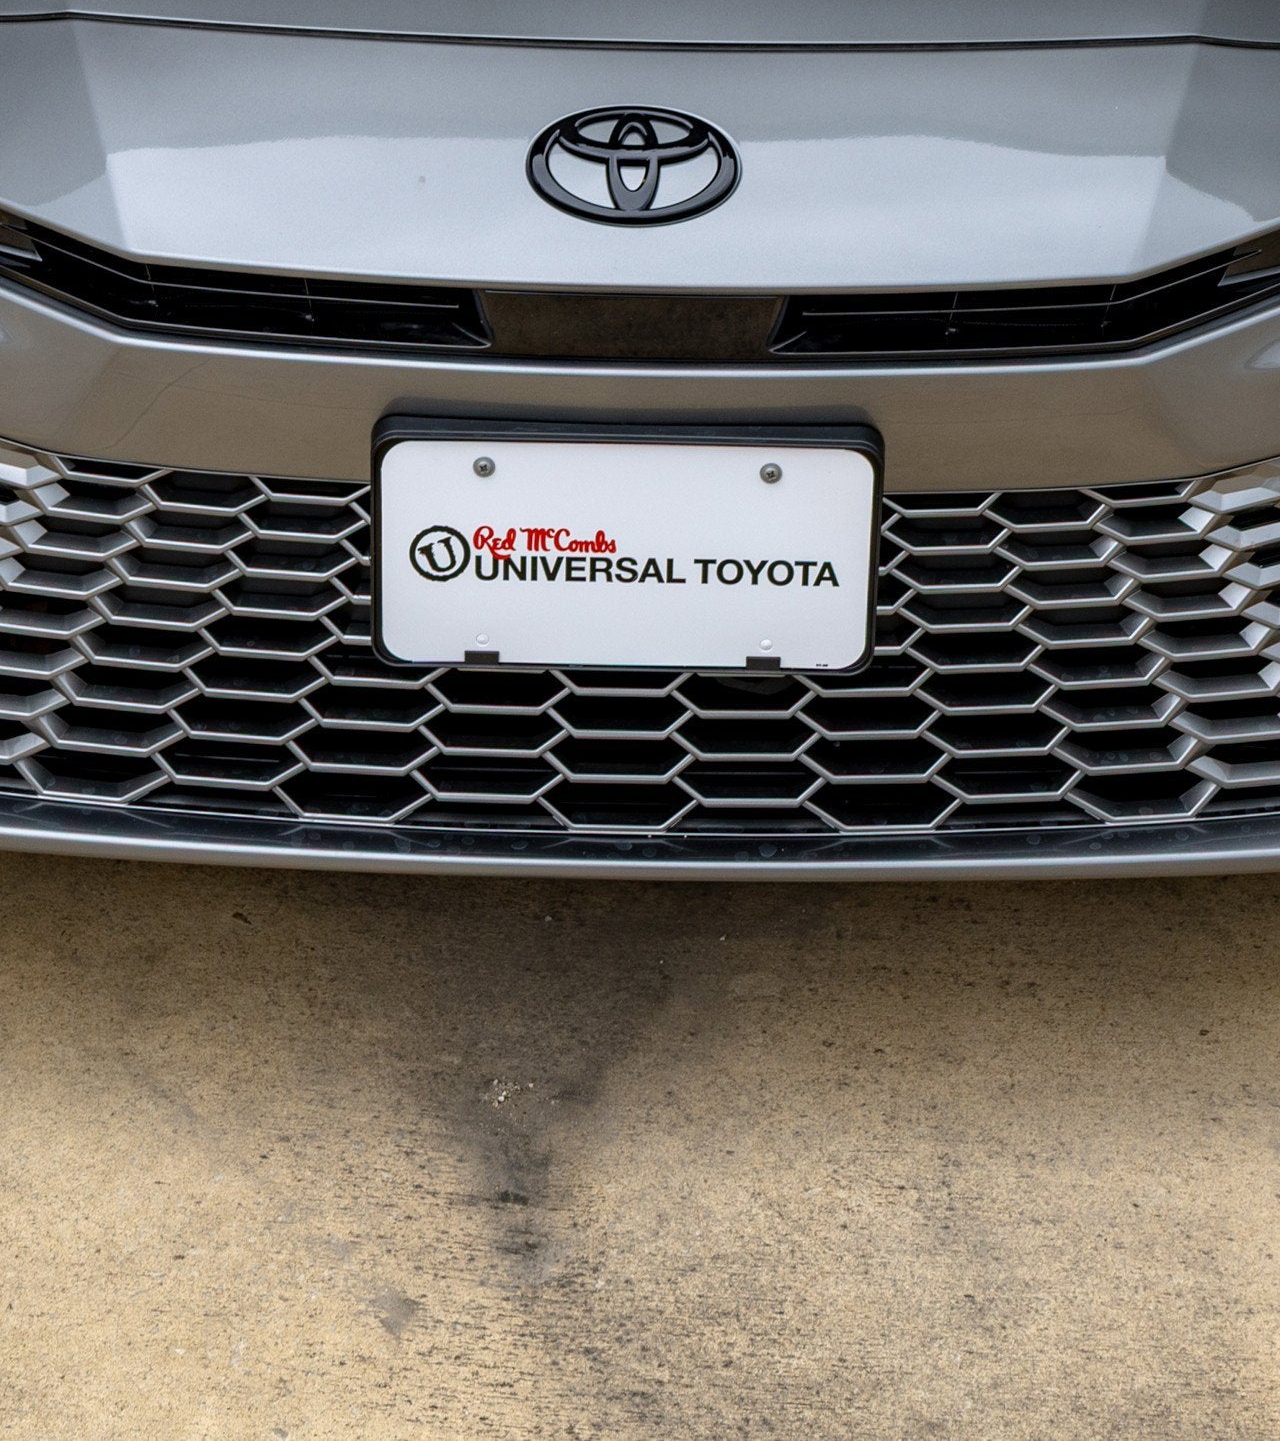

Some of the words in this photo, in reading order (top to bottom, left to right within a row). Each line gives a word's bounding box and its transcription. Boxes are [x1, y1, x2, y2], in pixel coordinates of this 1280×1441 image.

[473, 525, 517, 560] Red
[519, 527, 617, 554] McCombs
[474, 555, 686, 585] UNIVERSAL
[694, 558, 840, 588] TOYOTA
